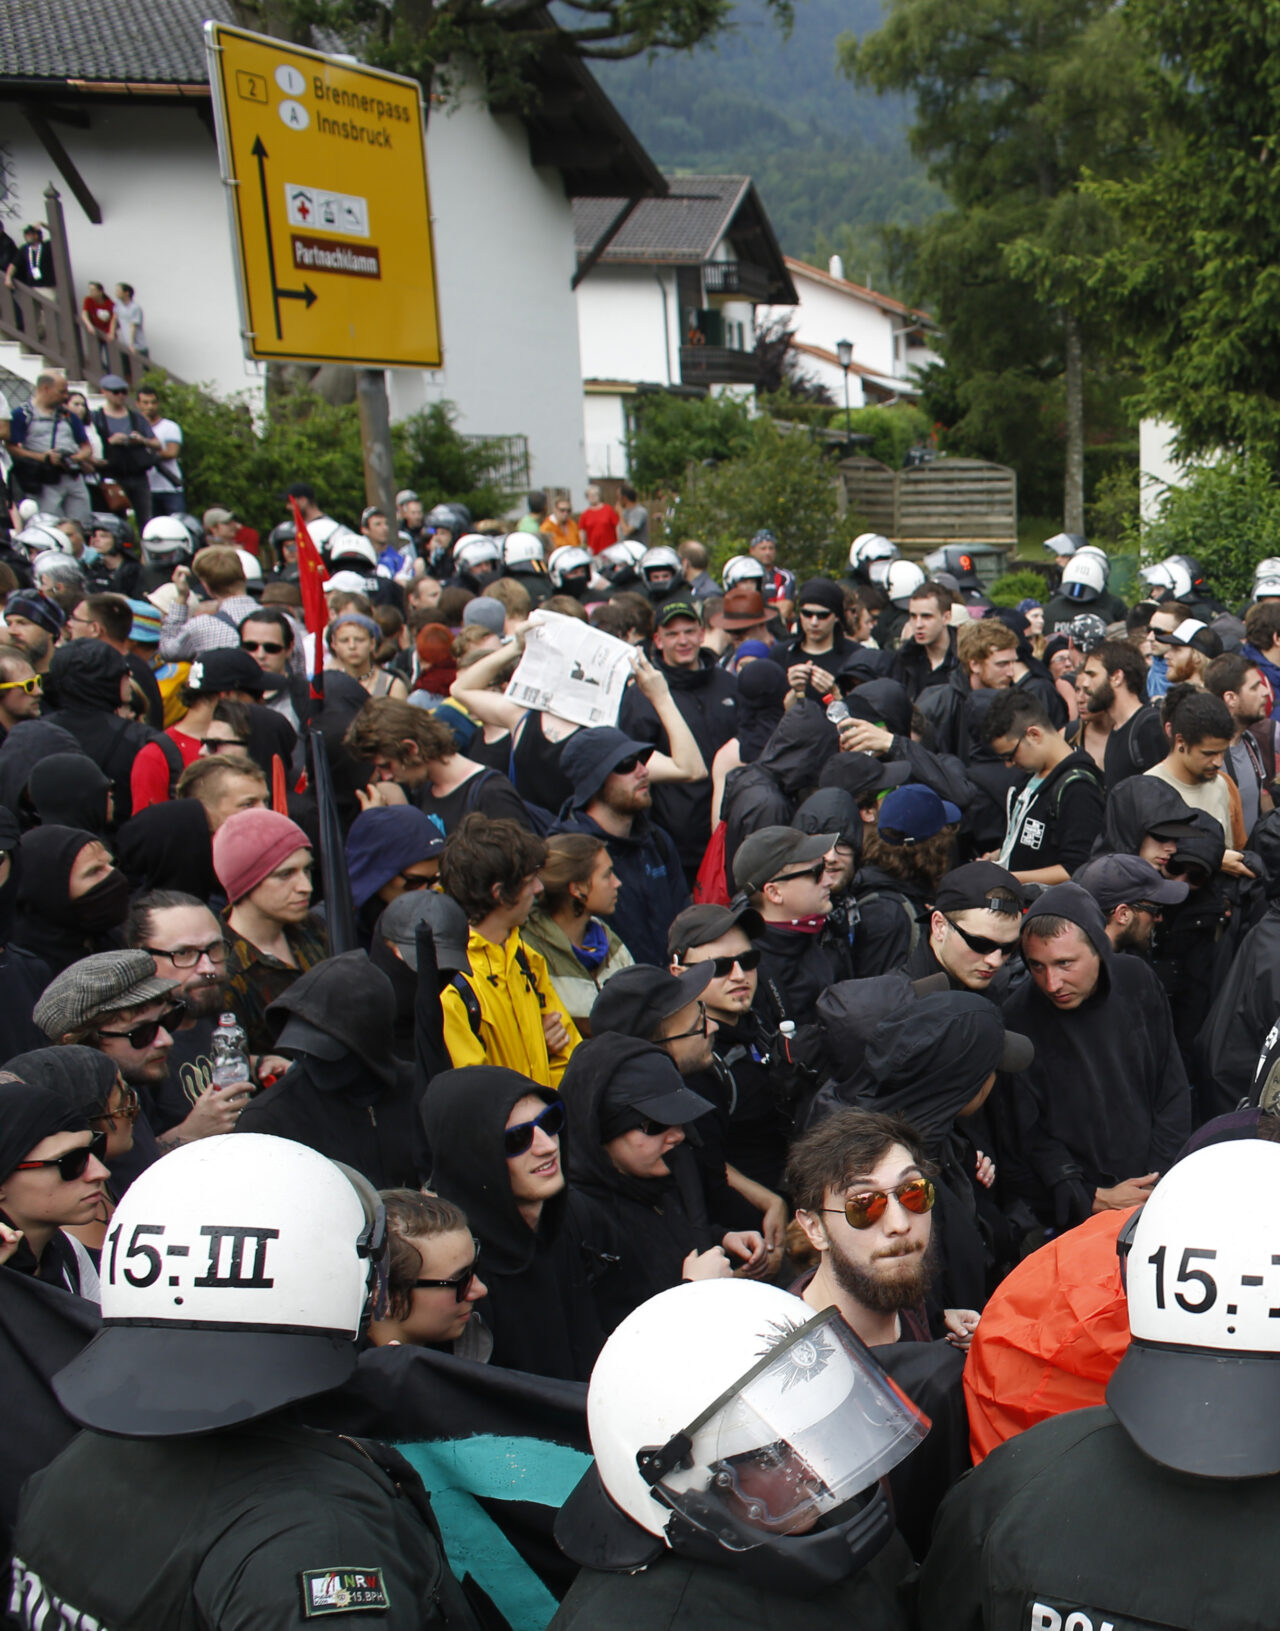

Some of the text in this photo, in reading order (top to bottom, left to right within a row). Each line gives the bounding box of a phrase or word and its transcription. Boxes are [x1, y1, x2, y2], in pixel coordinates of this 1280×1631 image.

[248, 79, 257, 97] 2
[313, 76, 411, 123] Brennerpass
[289, 106, 393, 149] A Innsbruck
[294, 242, 380, 274] Partnachklamm
[344, 1574, 376, 1589] NRW
